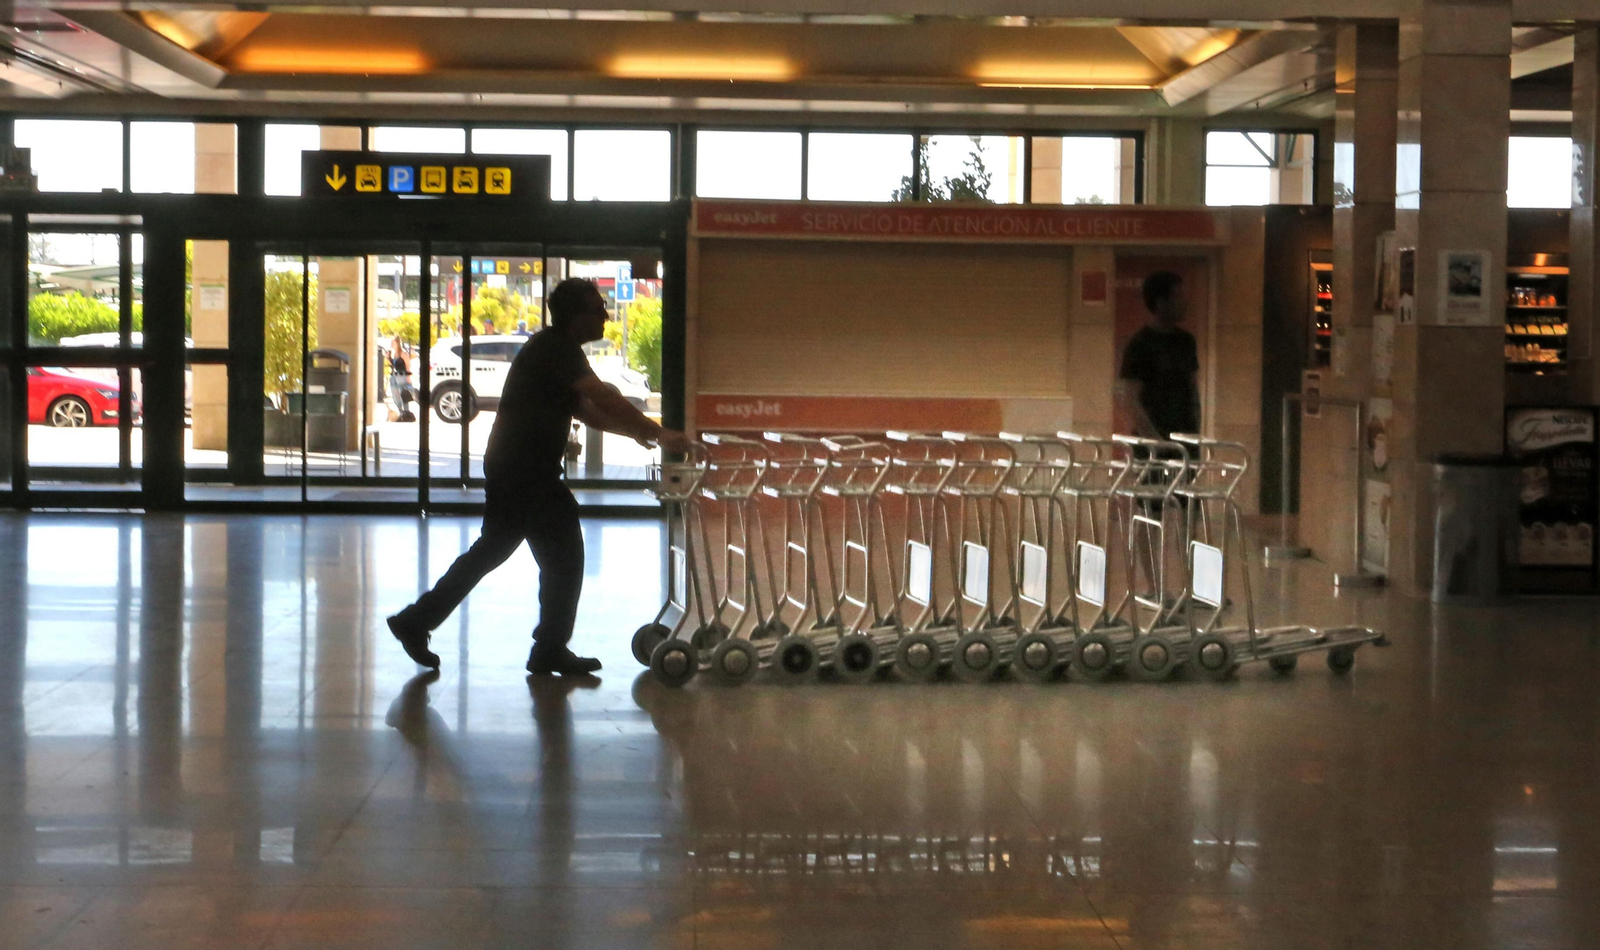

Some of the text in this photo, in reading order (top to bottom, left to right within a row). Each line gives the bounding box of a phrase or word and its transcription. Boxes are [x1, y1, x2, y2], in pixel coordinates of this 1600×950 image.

[393, 168, 410, 189] P
[713, 210, 778, 227] easyJet
[801, 212, 893, 232] SERVICIO
[898, 215, 924, 232] DE
[1034, 217, 1058, 234] AL
[1063, 217, 1144, 235] CLIENTE
[715, 400, 782, 418] easyJet
